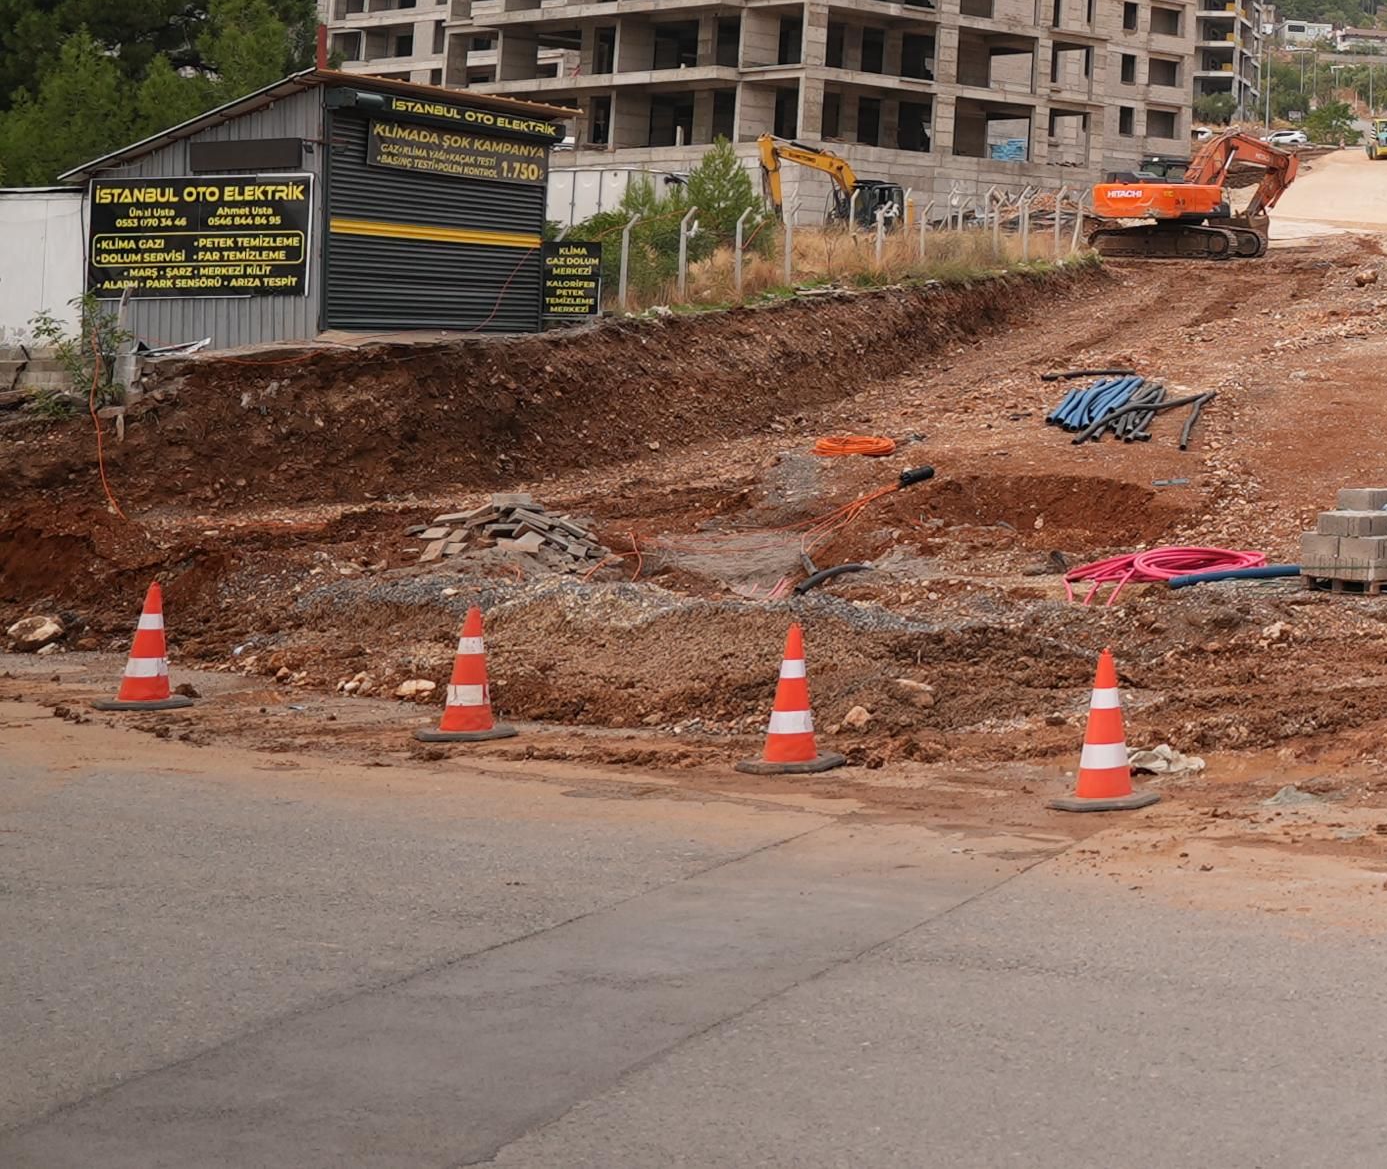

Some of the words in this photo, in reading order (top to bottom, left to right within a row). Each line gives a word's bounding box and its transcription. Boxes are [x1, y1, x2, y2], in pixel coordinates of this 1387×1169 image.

[392, 97, 461, 119] İSTANBUL
[464, 110, 494, 125] OTO
[497, 116, 556, 136] ELEKTRİK
[373, 123, 439, 145] KLİMADA
[441, 134, 471, 149] ŞOK
[473, 139, 545, 159] KAMPANYA
[95, 185, 179, 204] İSTANBUL
[183, 186, 219, 202] OTO
[223, 182, 305, 201] ELEKTRİK
[1107, 190, 1142, 198] HITACHI
[153, 207, 175, 217] Usta
[216, 206, 250, 215] Ahmet
[251, 206, 273, 215] Usta
[115, 218, 138, 228] 0553
[159, 217, 172, 227] 34
[207, 217, 232, 226] 0546
[233, 216, 253, 225] 844
[268, 216, 281, 225] 95
[101, 237, 136, 249] KLİMA
[139, 239, 164, 249] GAZI
[199, 237, 235, 248] PETEK
[236, 234, 300, 247] TEMİZLEME
[198, 251, 220, 261] FAR
[222, 248, 286, 260] TEMİZLEME
[558, 245, 588, 255] KLİMA
[101, 253, 141, 263] DOLUM
[143, 250, 185, 262] SERVİSİ
[545, 257, 565, 265] GAZ
[566, 257, 599, 265] DOLUM
[129, 268, 158, 278] MARŞ
[165, 267, 192, 277] ŞARZ
[199, 264, 244, 276] MERKEZİ
[246, 264, 272, 275] KİLİT
[552, 266, 592, 275] MERKEZİ
[146, 279, 175, 289] PARK
[175, 277, 222, 288] SENSÖRÜ
[229, 277, 261, 287] ARIZA
[262, 275, 298, 286] TESPİT
